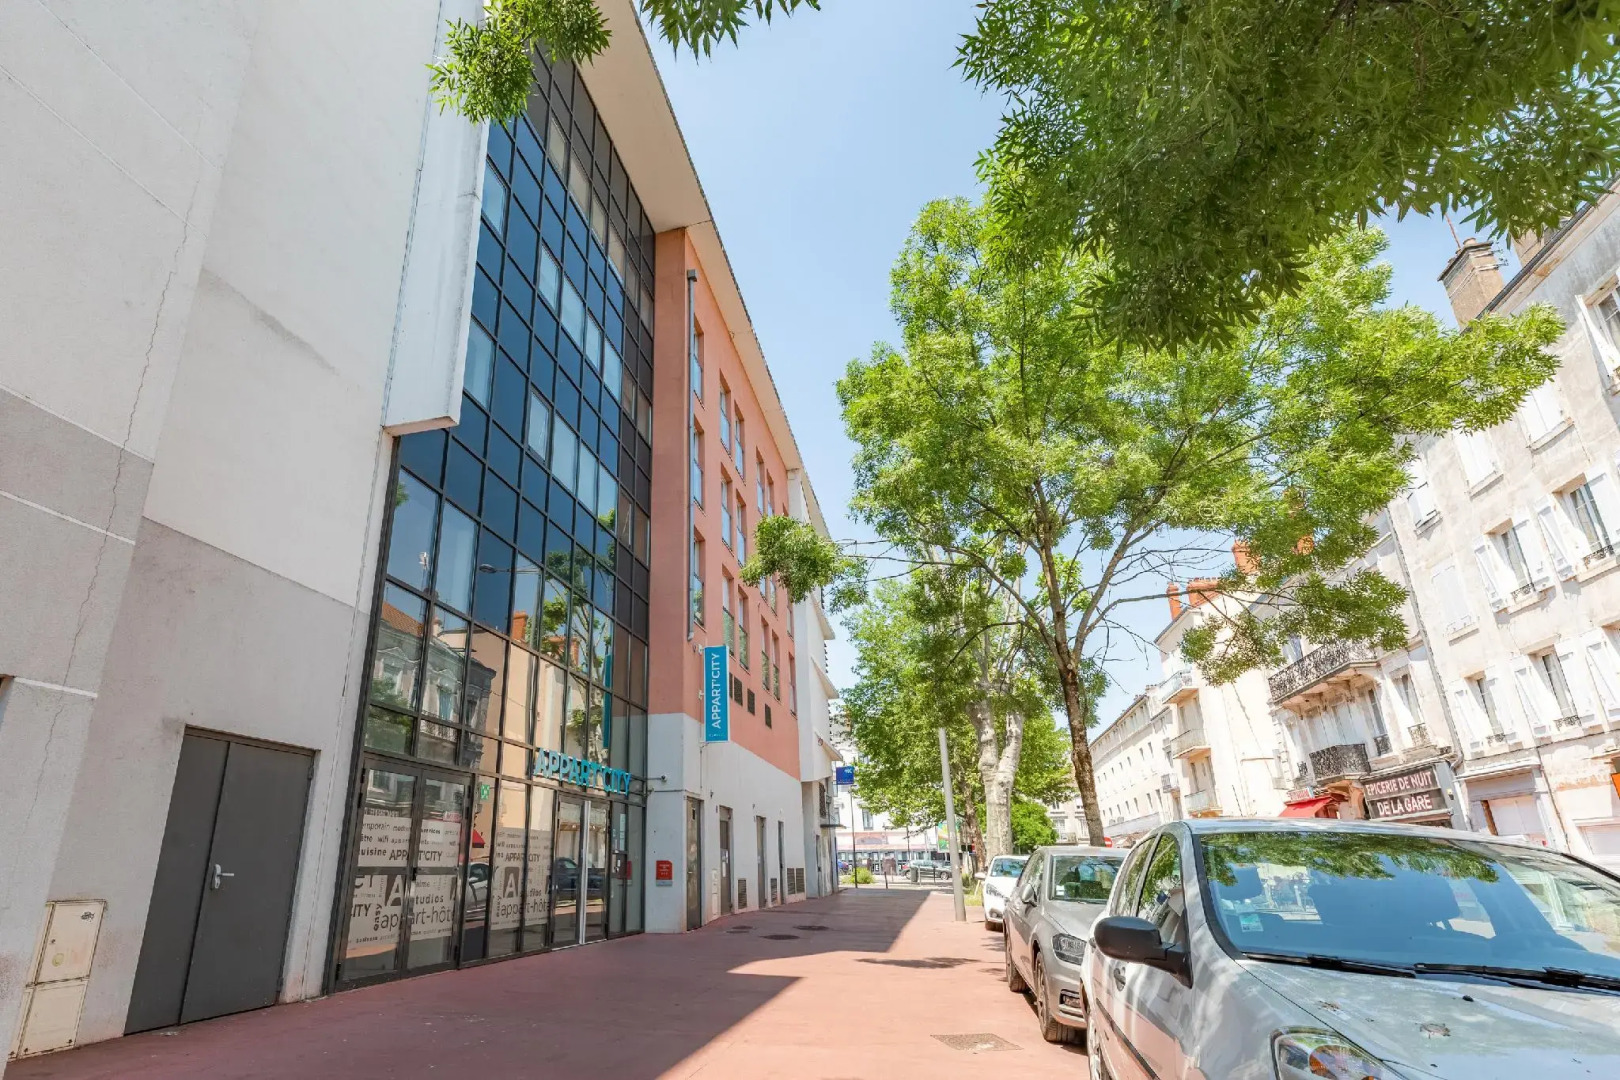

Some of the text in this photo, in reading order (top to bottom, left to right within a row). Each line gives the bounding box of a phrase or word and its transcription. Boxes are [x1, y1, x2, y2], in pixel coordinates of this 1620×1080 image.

[711, 652, 721, 729] APPART'CITY
[533, 747, 632, 797] APPART'CITY
[1365, 771, 1433, 796] EPICERIE DE NUIT
[1376, 794, 1433, 816] DE LA GARE
